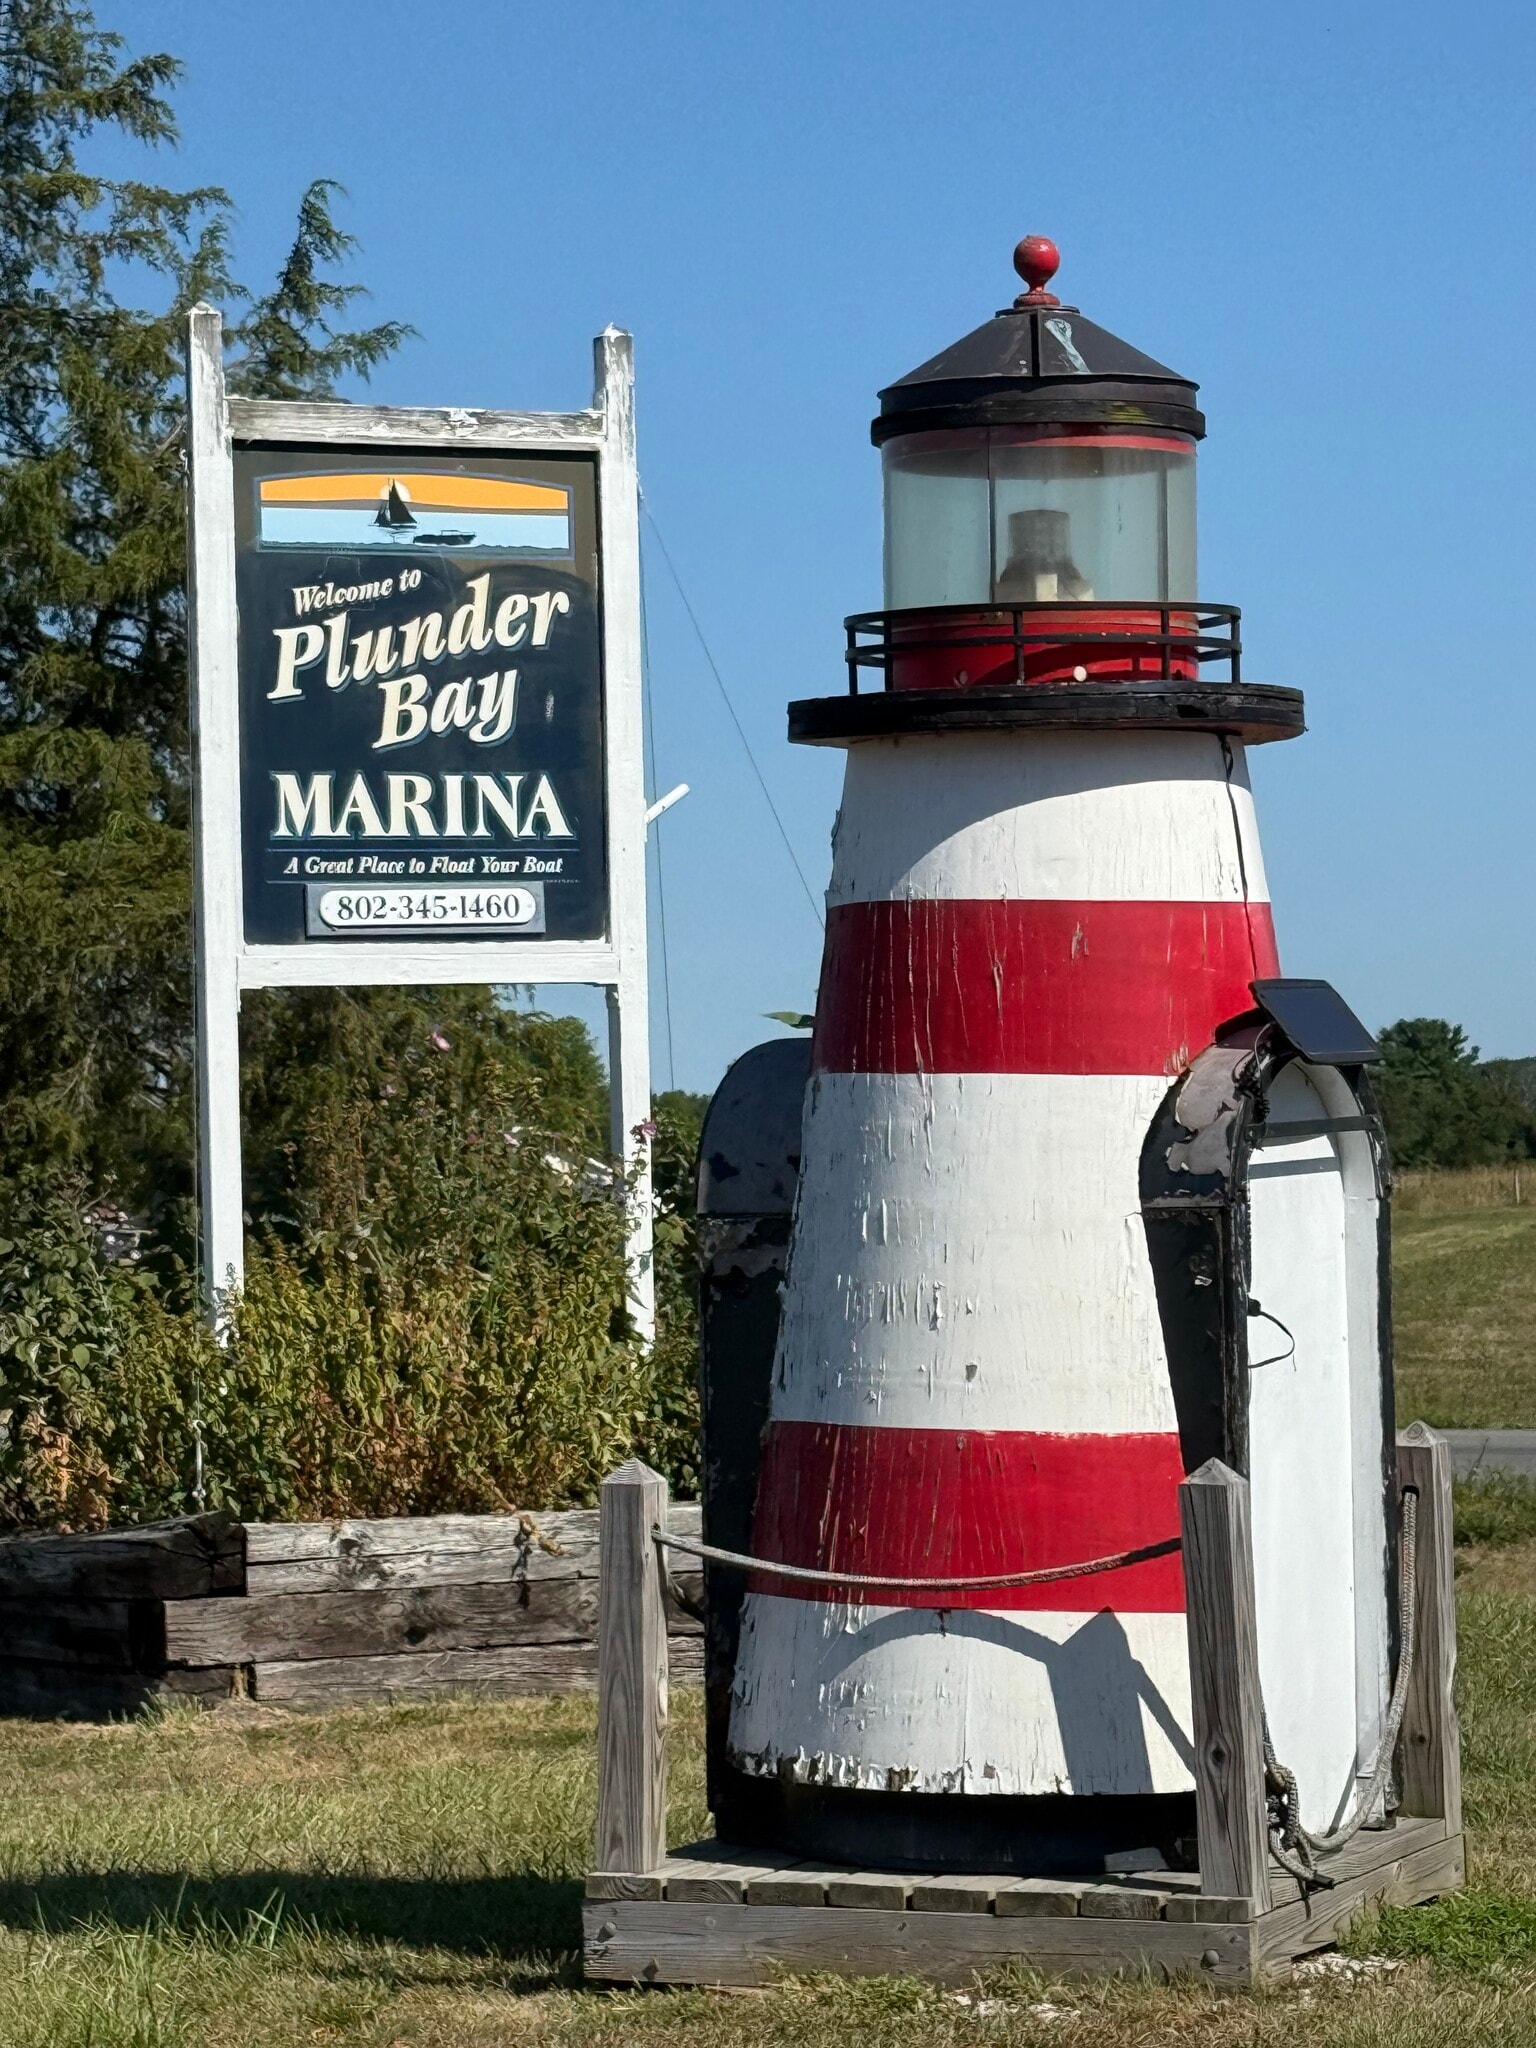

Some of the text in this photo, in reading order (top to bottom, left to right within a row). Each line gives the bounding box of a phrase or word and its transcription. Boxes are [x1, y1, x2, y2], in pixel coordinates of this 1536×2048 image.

[292, 569, 422, 615] Welcome to
[266, 573, 570, 700] Plunder
[372, 668, 518, 750] Bay
[271, 772, 576, 838] MARINA
[283, 856, 563, 874] A Great Place to Float Your Boat
[336, 894, 520, 920] 802-345-1460
